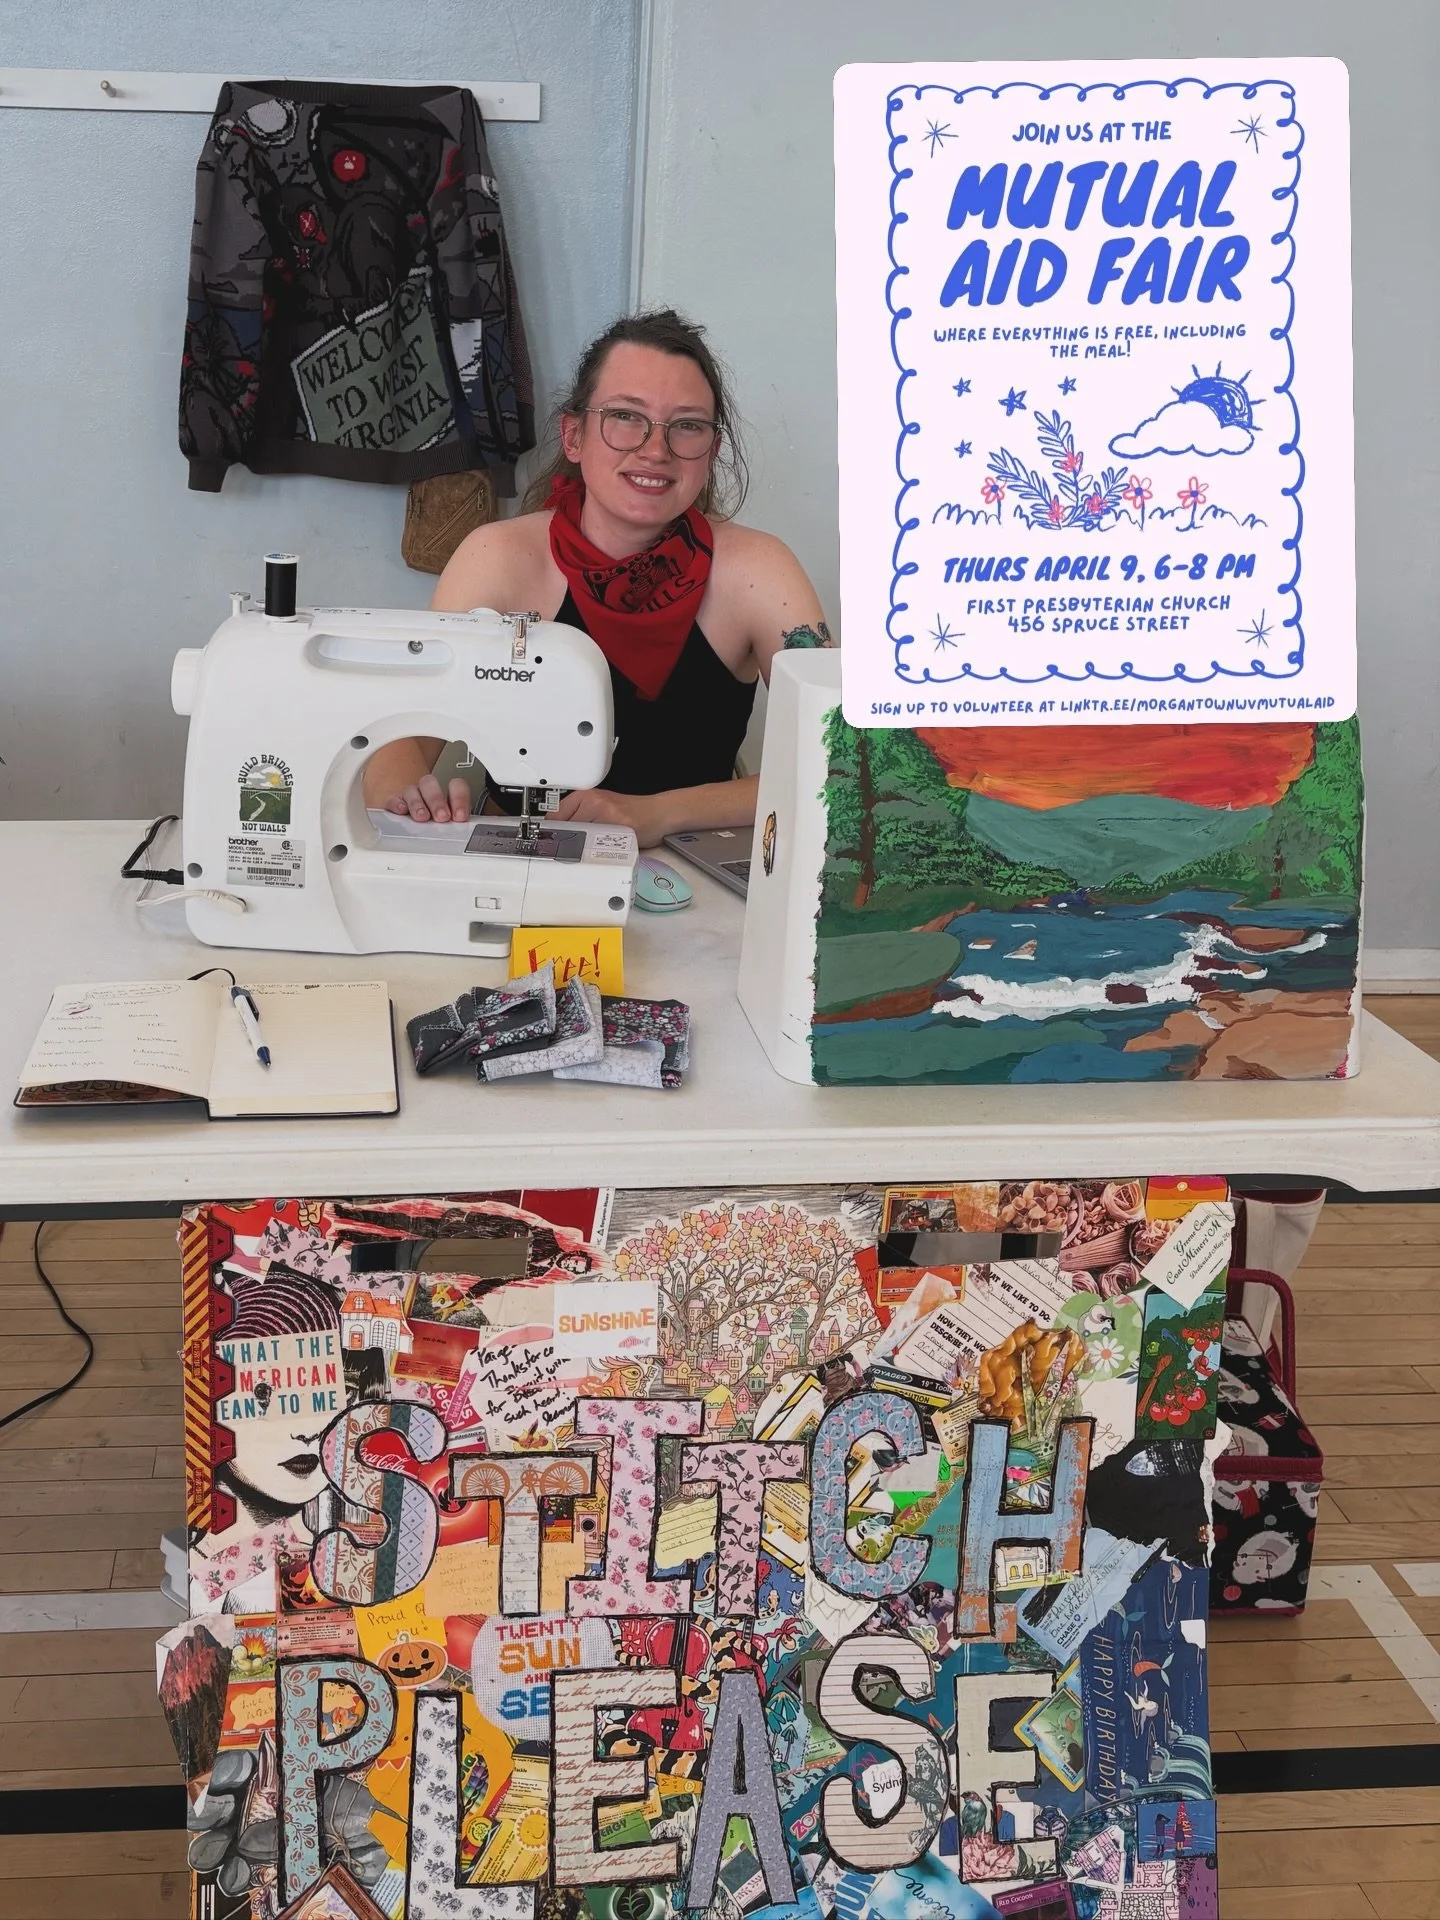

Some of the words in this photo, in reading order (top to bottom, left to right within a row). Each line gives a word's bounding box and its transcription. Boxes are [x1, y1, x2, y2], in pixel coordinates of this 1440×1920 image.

[303, 297, 422, 394] WELCOE
[327, 385, 367, 429] TO
[368, 335, 429, 405] WEST
[474, 665, 535, 683] brother
[237, 755, 259, 785] BUILD
[261, 754, 294, 787] BRIDGES
[228, 837, 258, 846] brother
[242, 822, 258, 832] NOT
[260, 823, 287, 833] WALLS
[528, 937, 600, 982] Free!
[1173, 1230, 1197, 1257] Greene
[1193, 1214, 1212, 1232] Coun
[1166, 1264, 1185, 1285] Coal
[989, 1271, 1001, 1284] AT
[1001, 1280, 1013, 1292] WE
[1028, 1302, 1039, 1313] TO
[1038, 1309, 1051, 1323] DO:
[558, 1307, 656, 1334] SUNSHINE
[936, 1313, 955, 1330] HOW
[955, 1325, 974, 1343] THEY
[221, 1340, 280, 1365] WHAT
[296, 1335, 335, 1359] THE
[240, 1363, 336, 1393] MERICAN
[480, 1361, 528, 1388] Thanks
[935, 1383, 953, 1394] Tool
[220, 1397, 256, 1421] EAN
[278, 1393, 300, 1415] TO
[312, 1391, 338, 1413] ME
[486, 1400, 506, 1416] for
[311, 1396, 1094, 1643] STITCH
[367, 1609, 406, 1626] Proud
[387, 1620, 428, 1644] yu!
[495, 1617, 582, 1641] TWENTY
[1056, 1622, 1077, 1645] CHASE
[499, 1637, 581, 1674] SUN
[1092, 1634, 1115, 1702] HAPPY
[496, 1685, 551, 1720] SE
[1095, 1706, 1117, 1802] BIRTHDAY
[276, 1632, 1060, 1920] PLEASE
[872, 1778, 903, 1793] Sydn
[600, 1818, 627, 1838] ERGY
[1010, 1893, 1034, 1904] COCOON
